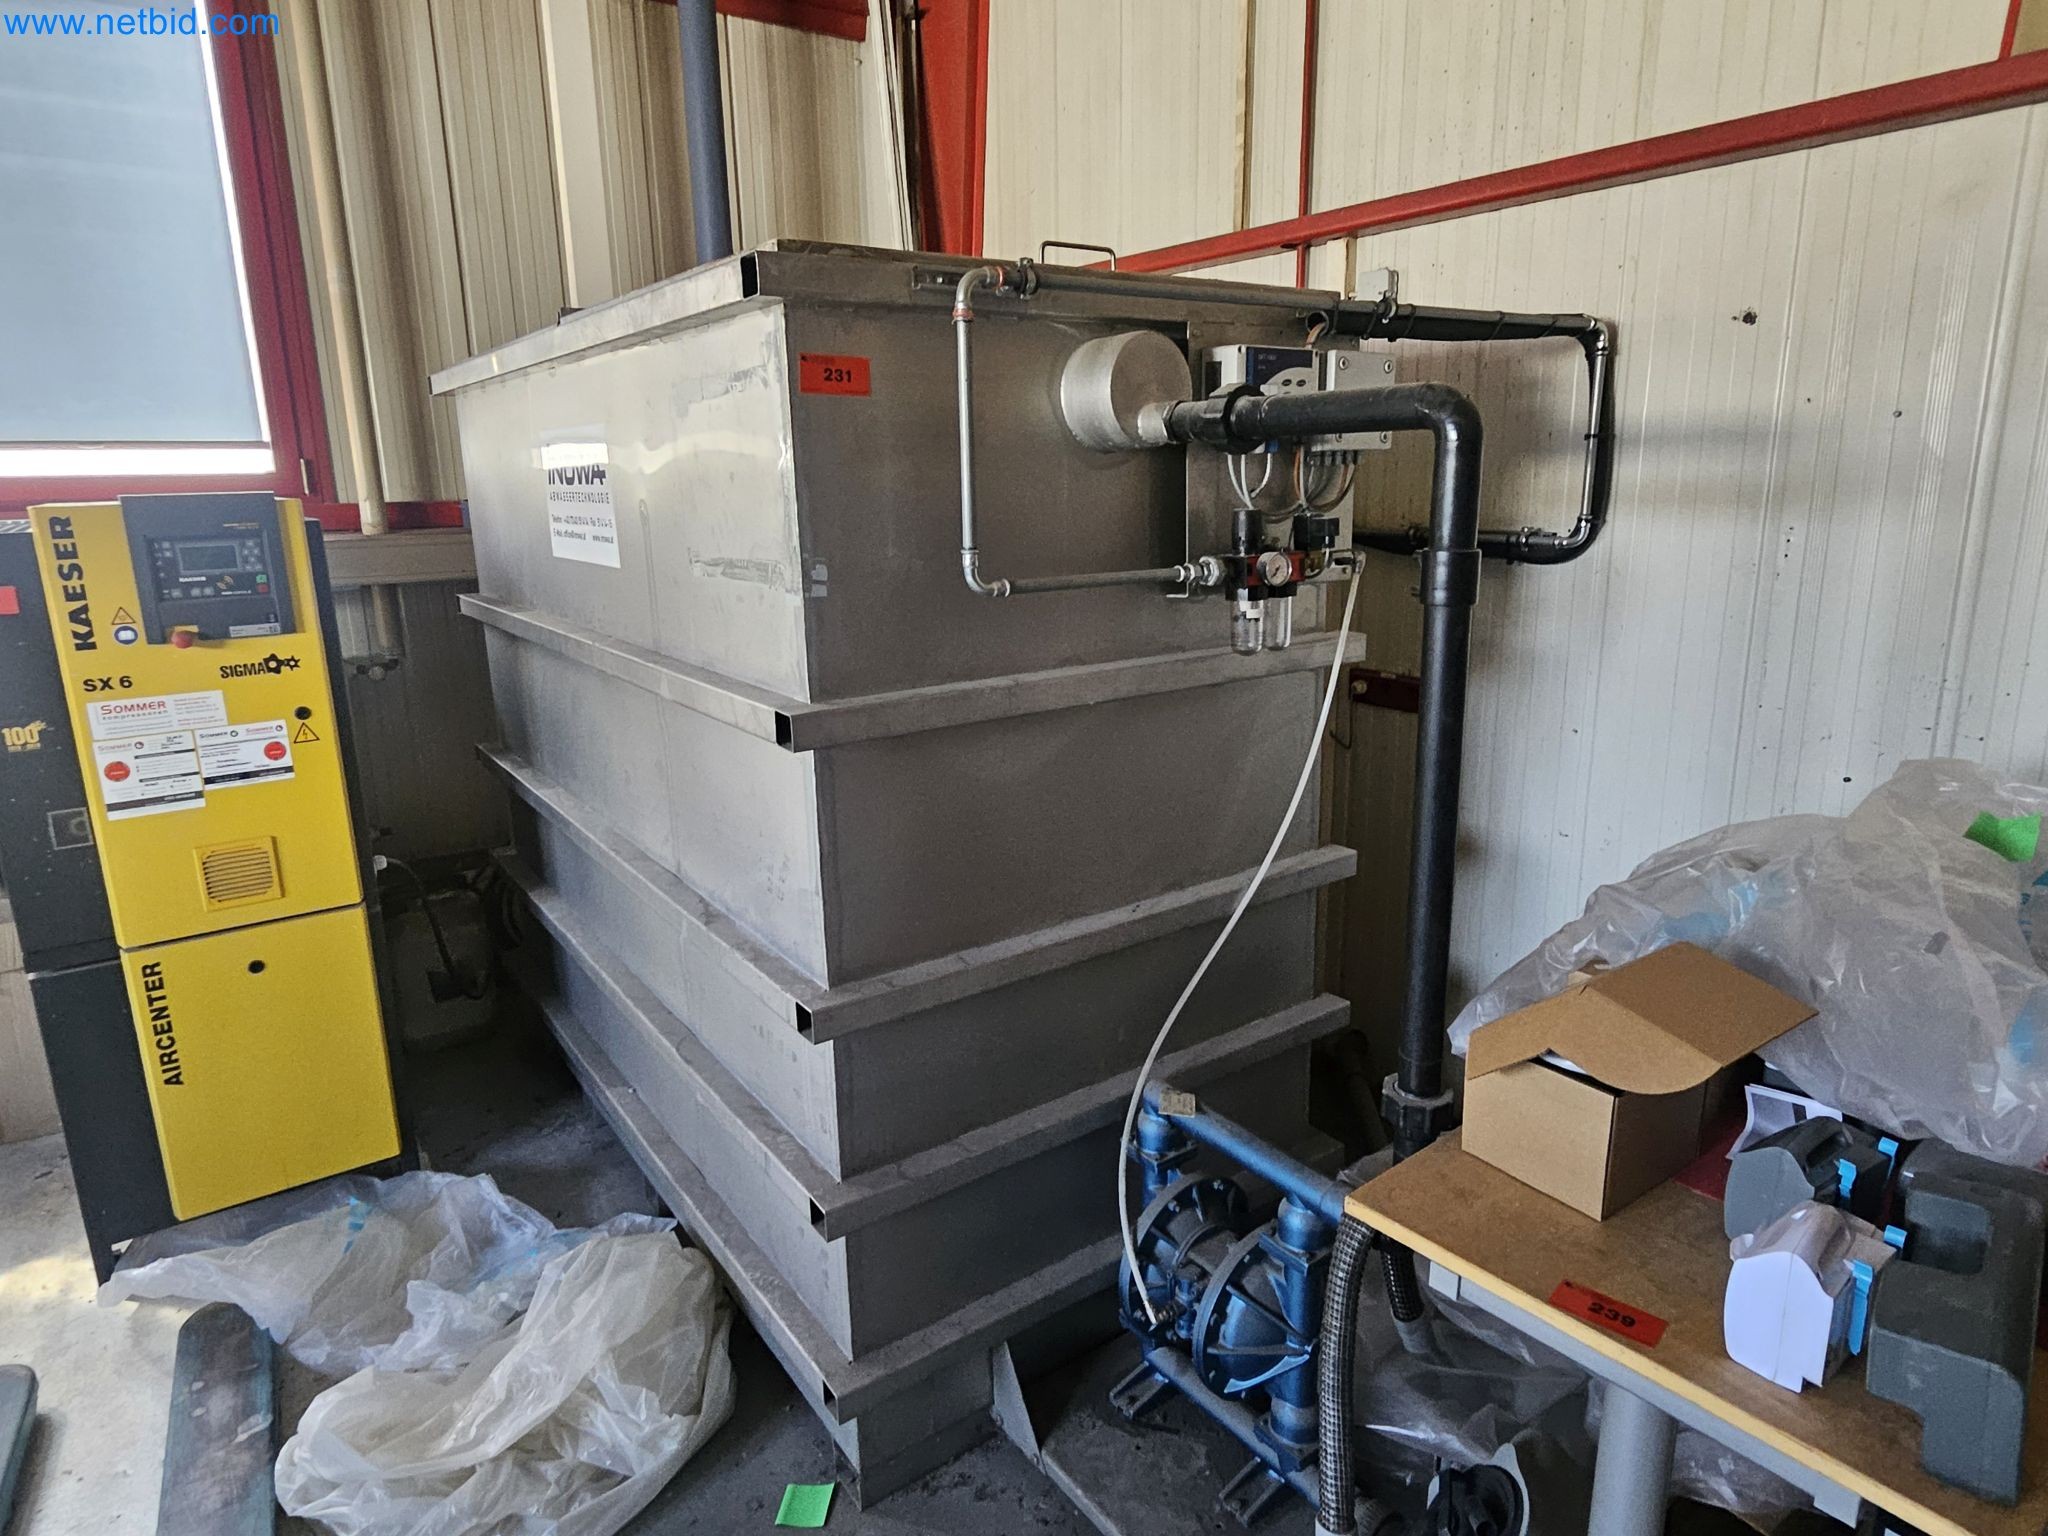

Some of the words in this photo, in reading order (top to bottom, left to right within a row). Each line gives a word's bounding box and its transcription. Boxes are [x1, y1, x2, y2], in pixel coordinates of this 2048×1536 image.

[823, 367, 851, 383] 231
[48, 515, 98, 652] KAESER
[219, 664, 266, 679] SIGMA
[83, 677, 114, 692] SX
[119, 675, 133, 689] 6
[141, 961, 185, 1086] AIRCENTER
[1587, 1301, 1636, 1328] 239
